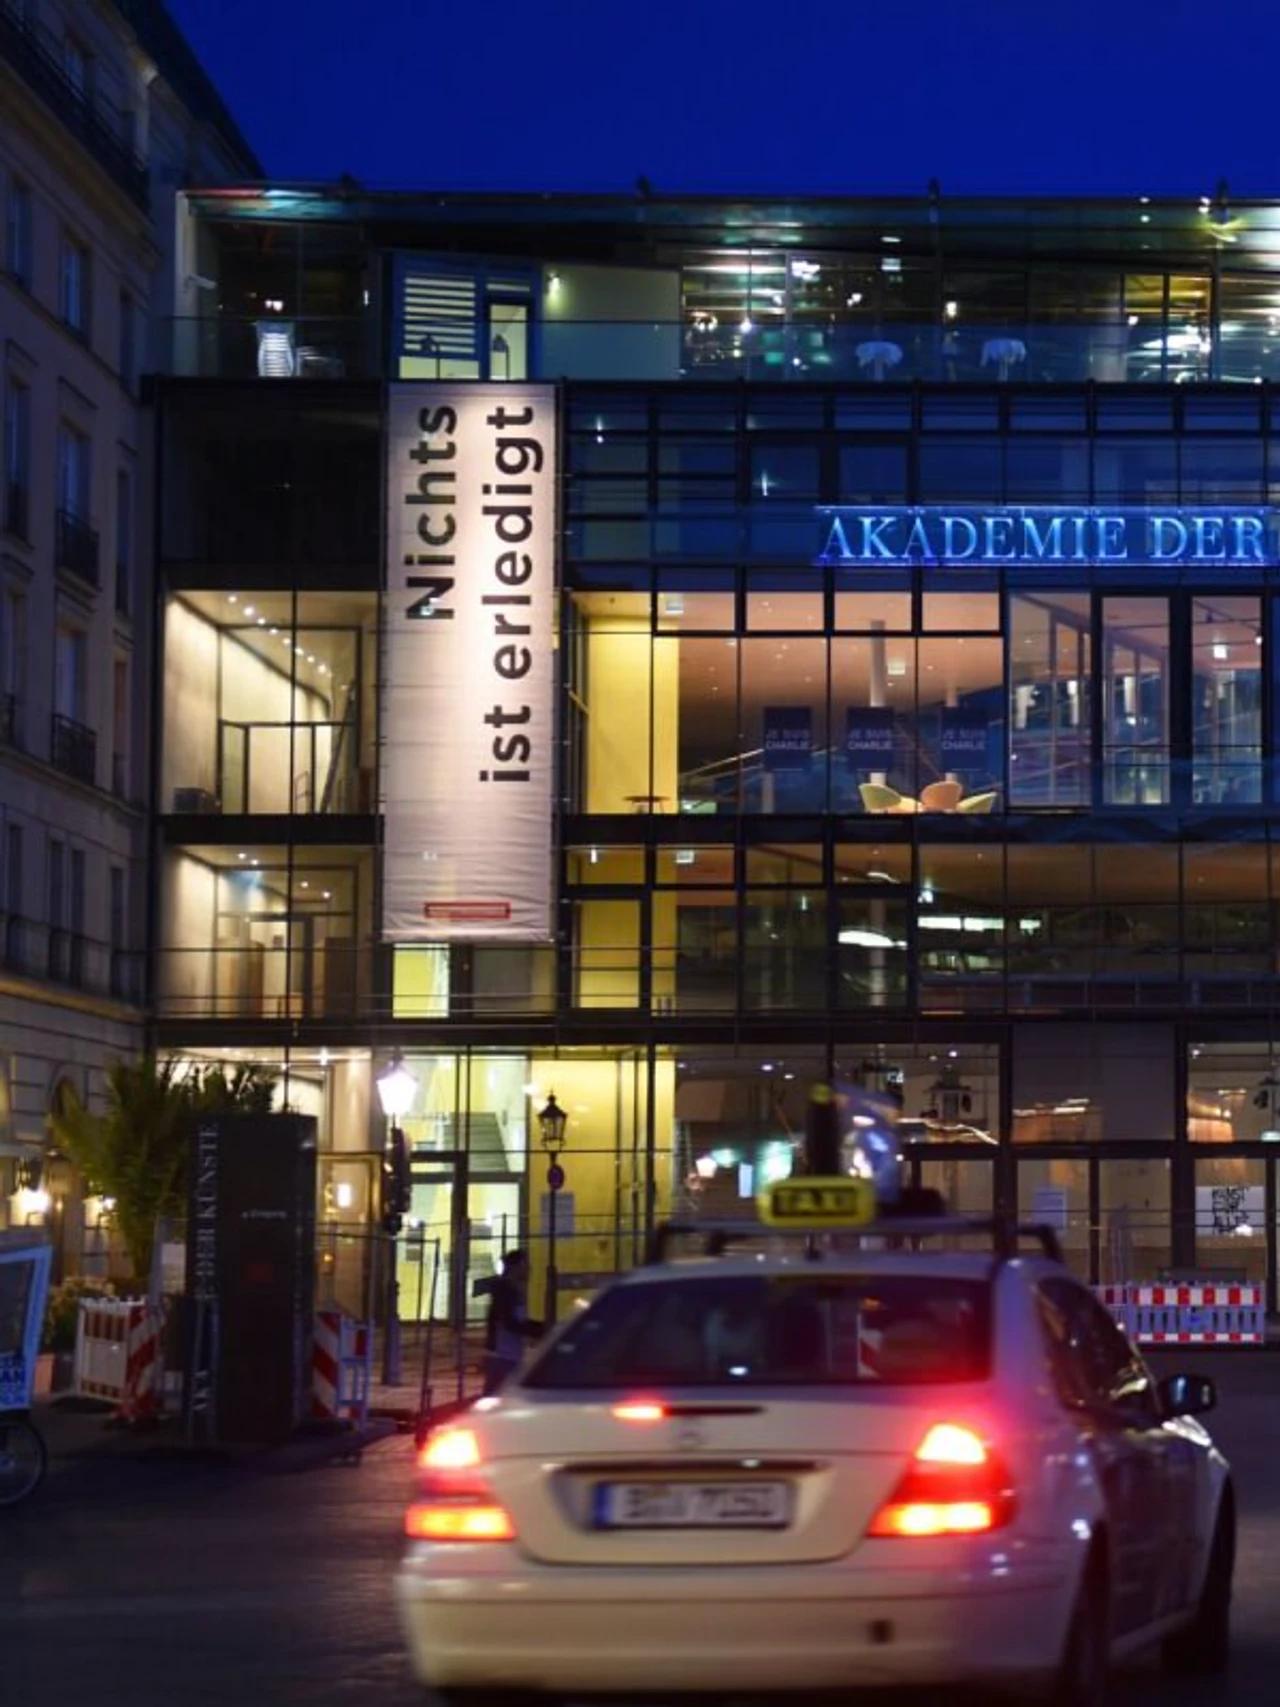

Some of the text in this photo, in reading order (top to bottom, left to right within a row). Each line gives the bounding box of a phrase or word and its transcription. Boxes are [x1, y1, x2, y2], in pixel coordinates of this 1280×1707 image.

[404, 405, 458, 620] Nichts
[818, 517, 1130, 559] AKADEMIE
[1148, 515, 1266, 560] DER
[479, 406, 543, 783] ist erledigt
[194, 1122, 219, 1220] KÜNSTE
[775, 1189, 855, 1214] TAXI
[194, 1228, 217, 1278] DER
